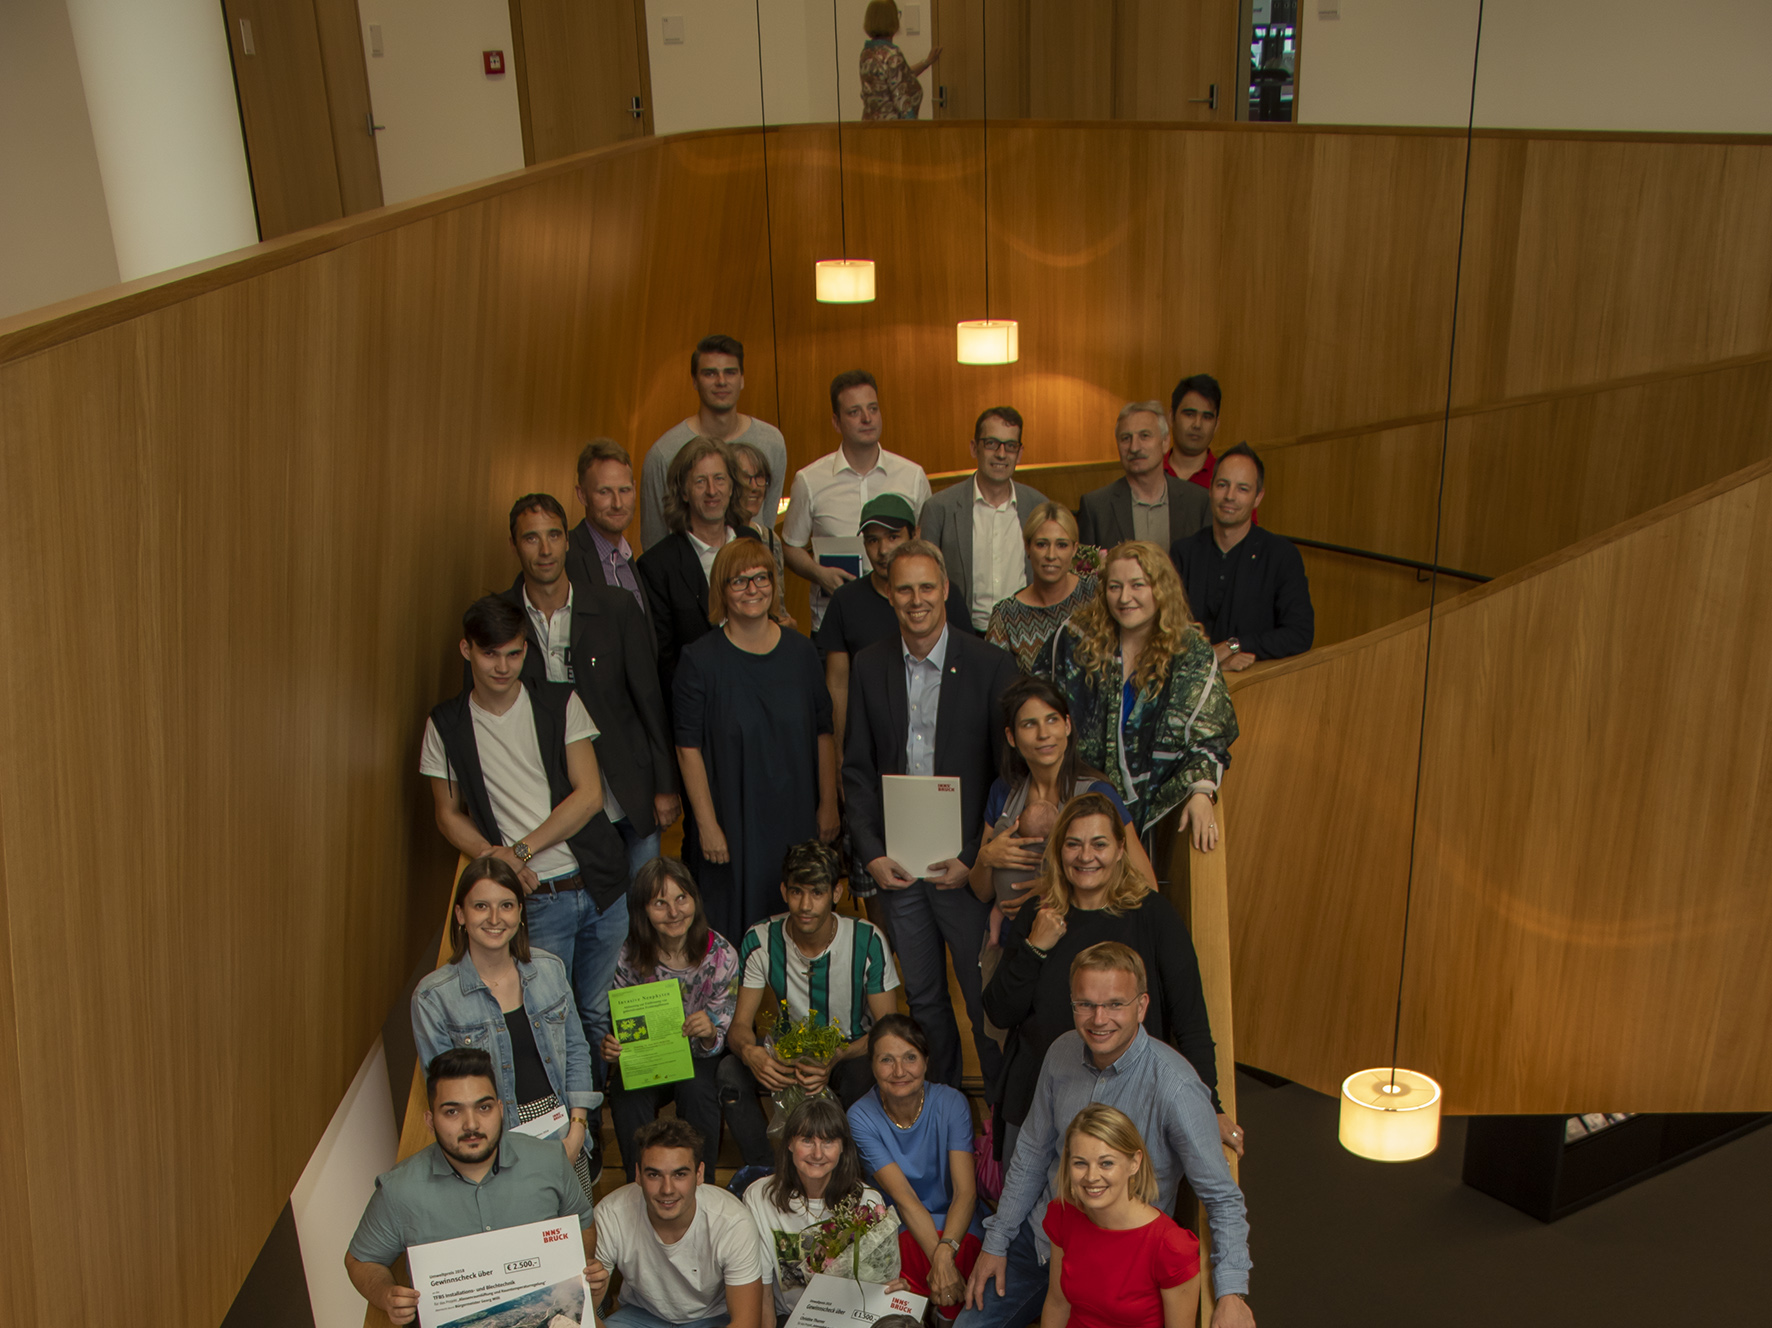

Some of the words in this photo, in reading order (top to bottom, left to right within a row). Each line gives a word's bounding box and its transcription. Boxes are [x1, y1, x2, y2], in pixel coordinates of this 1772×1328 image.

[543, 1233, 568, 1243] BRUCK
[430, 1273, 477, 1287] Gewinnscheck
[477, 1270, 493, 1278] über
[445, 1289, 475, 1298] Installations-
[806, 1304, 835, 1313] Gewinnscheck
[890, 1303, 912, 1314] BRUCK
